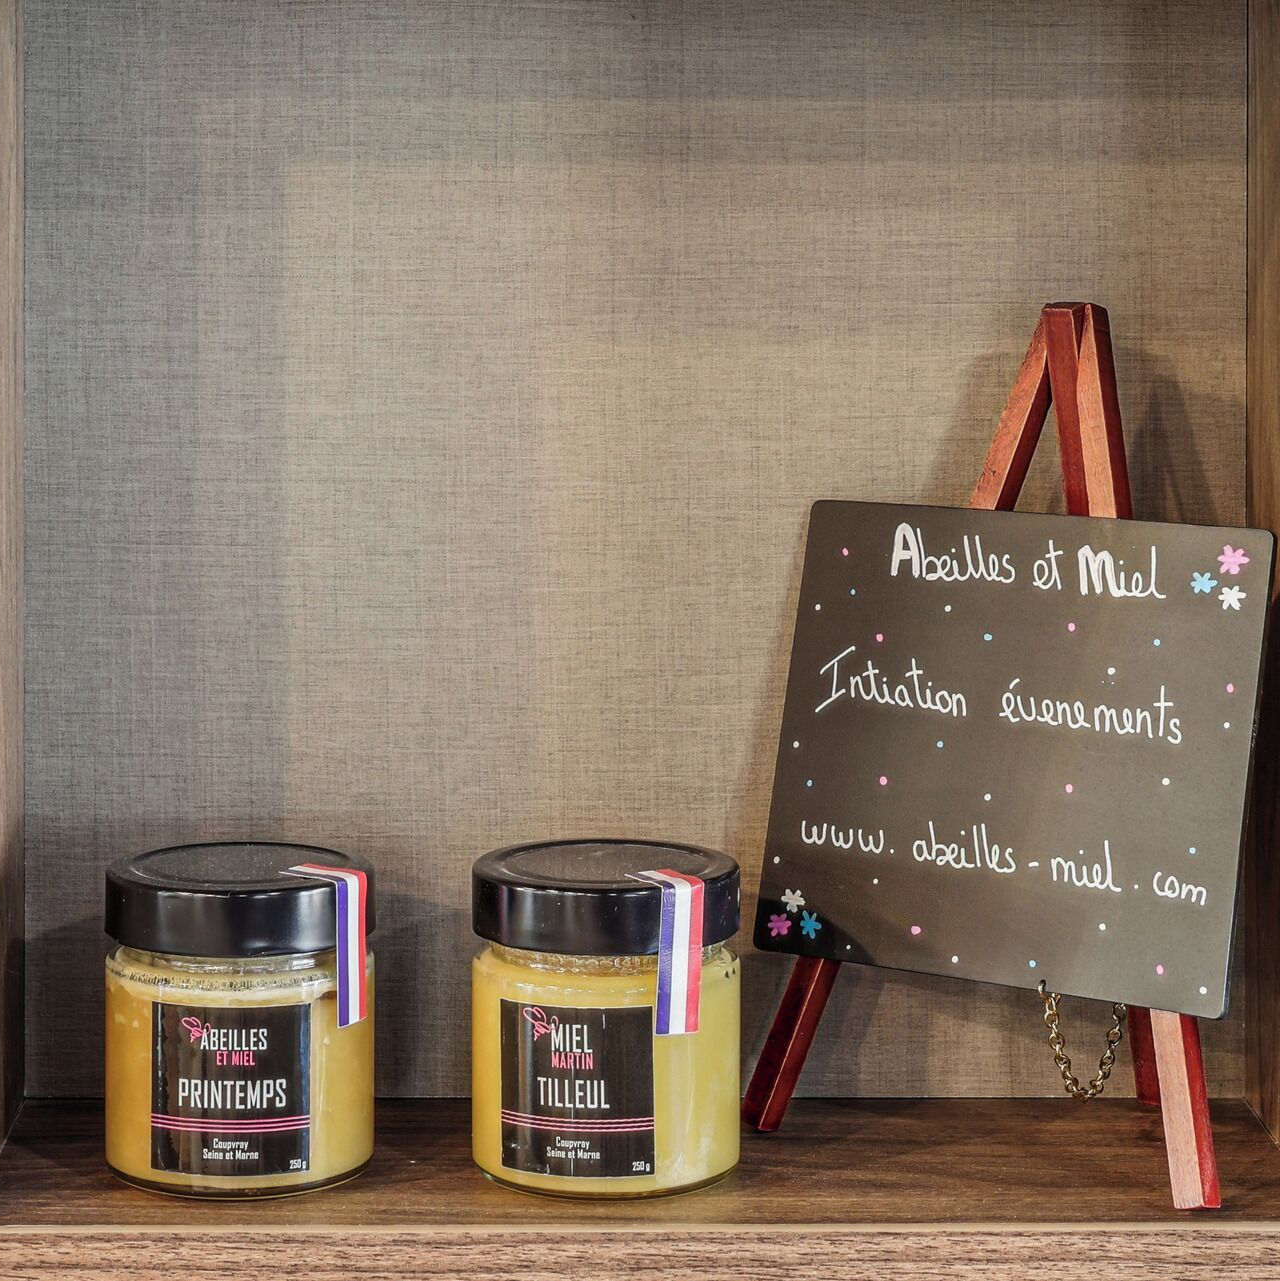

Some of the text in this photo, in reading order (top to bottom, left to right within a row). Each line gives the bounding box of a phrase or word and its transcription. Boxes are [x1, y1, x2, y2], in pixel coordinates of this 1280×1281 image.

[891, 521, 1166, 599] Abeilles et Miel
[200, 1028, 268, 1051] ABEILLES
[551, 1024, 593, 1053] MIEL
[216, 1050, 255, 1066] ET MIEL
[551, 1052, 593, 1070] MARTIN
[178, 1078, 287, 1110] PRINTEMPS
[537, 1076, 610, 1109] TILLEUL
[213, 1138, 249, 1151] Coupvray
[556, 1137, 590, 1150] Coupvray
